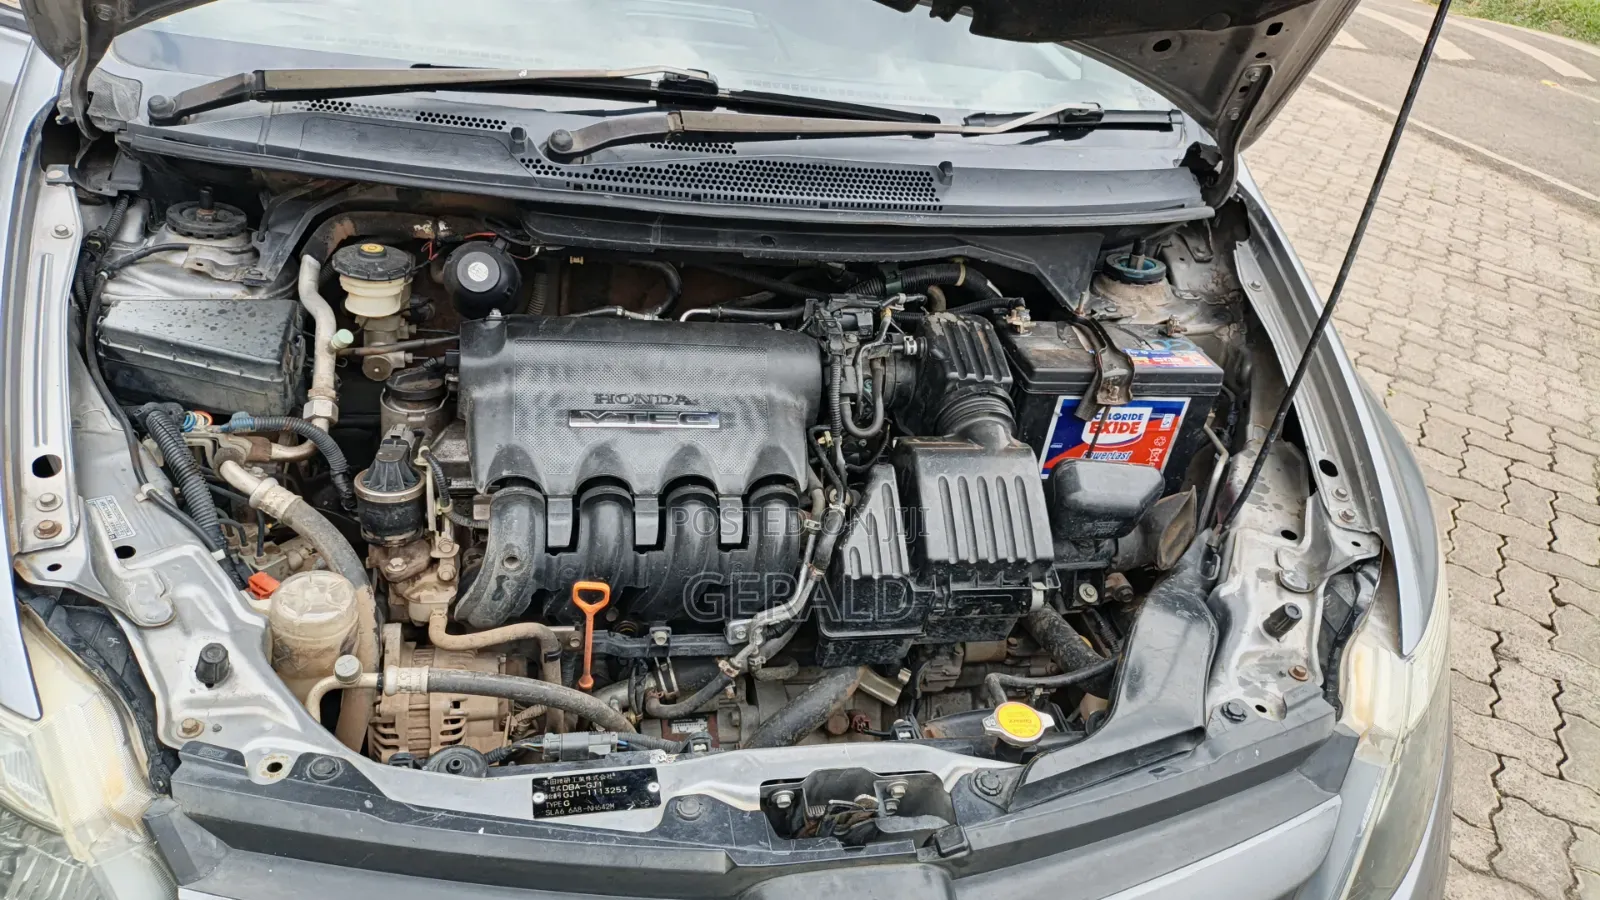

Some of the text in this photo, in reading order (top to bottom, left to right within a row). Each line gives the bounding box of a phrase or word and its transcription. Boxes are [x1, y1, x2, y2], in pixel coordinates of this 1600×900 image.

[593, 393, 692, 406] HONDA
[1094, 412, 1144, 421] CLORIDE
[1089, 421, 1141, 434] EXIDE
[562, 781, 603, 792] DBA-GJ1
[563, 785, 628, 799] GJ1-1113253
